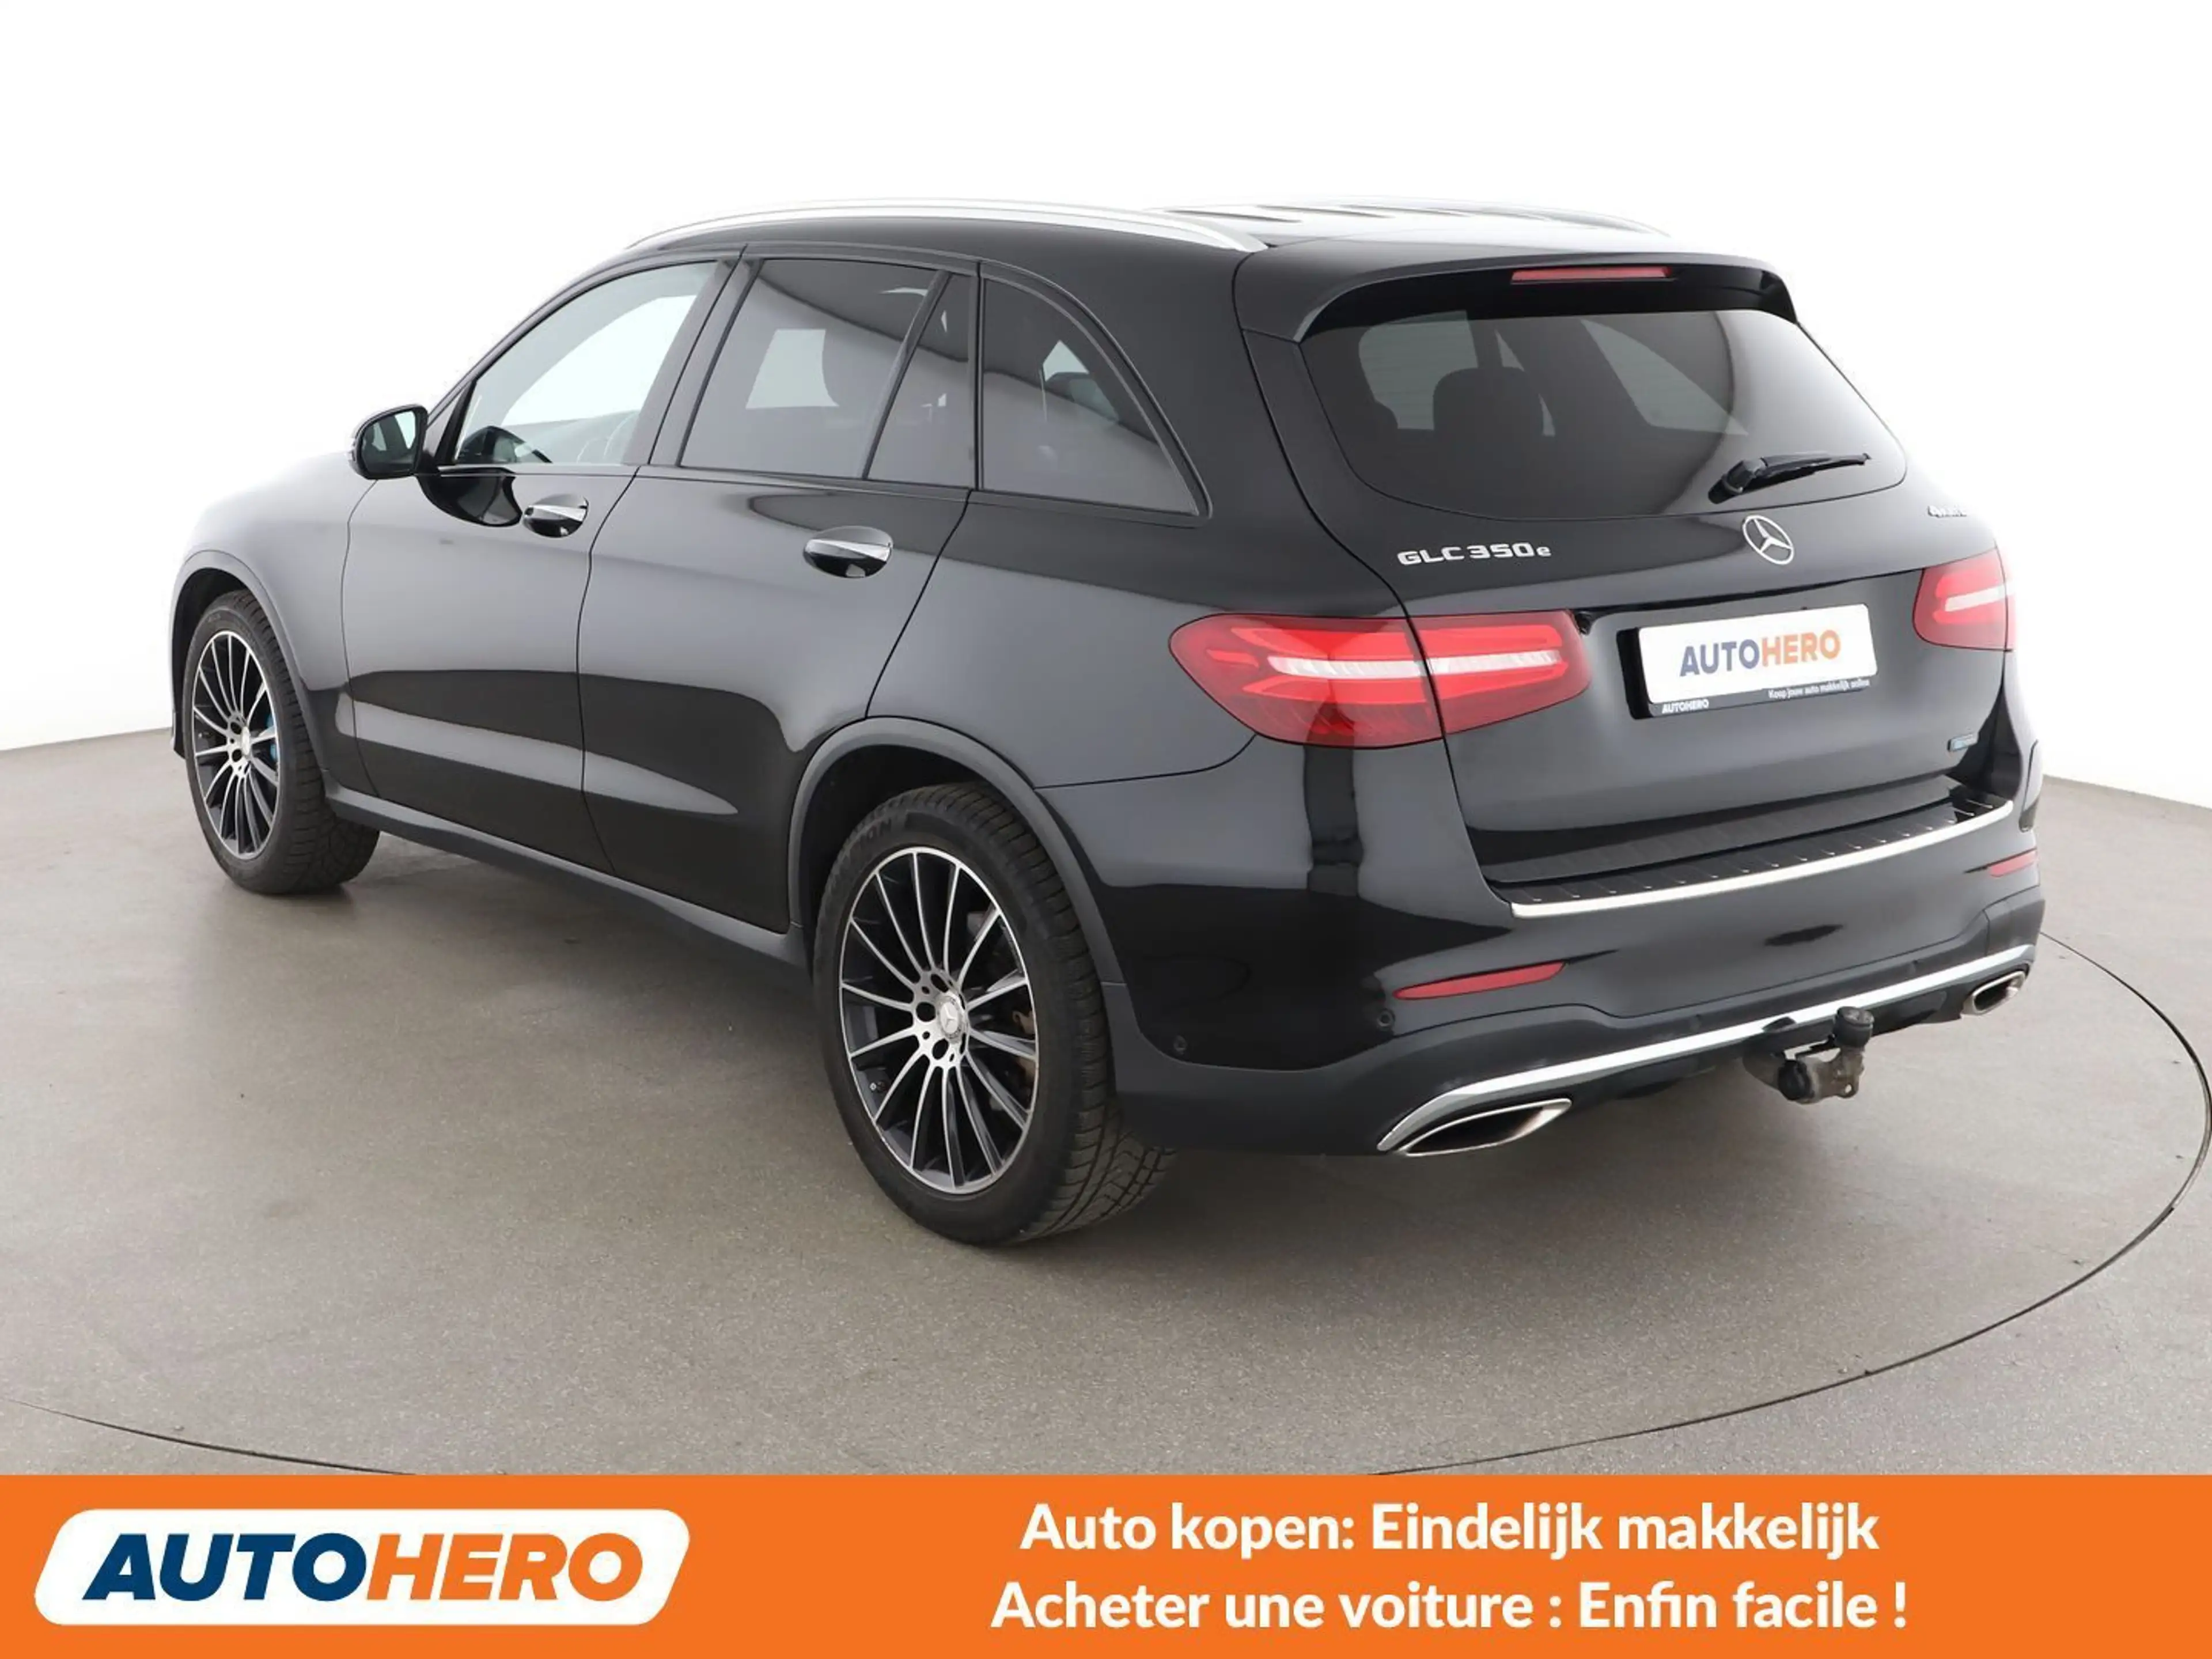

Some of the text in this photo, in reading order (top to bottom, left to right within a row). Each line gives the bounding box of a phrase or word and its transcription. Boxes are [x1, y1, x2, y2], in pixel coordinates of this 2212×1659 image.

[1397, 542, 1552, 565] GLC 350e
[1680, 630, 1841, 677] AUTOHERO
[1662, 699, 1710, 714] AUTOHERO
